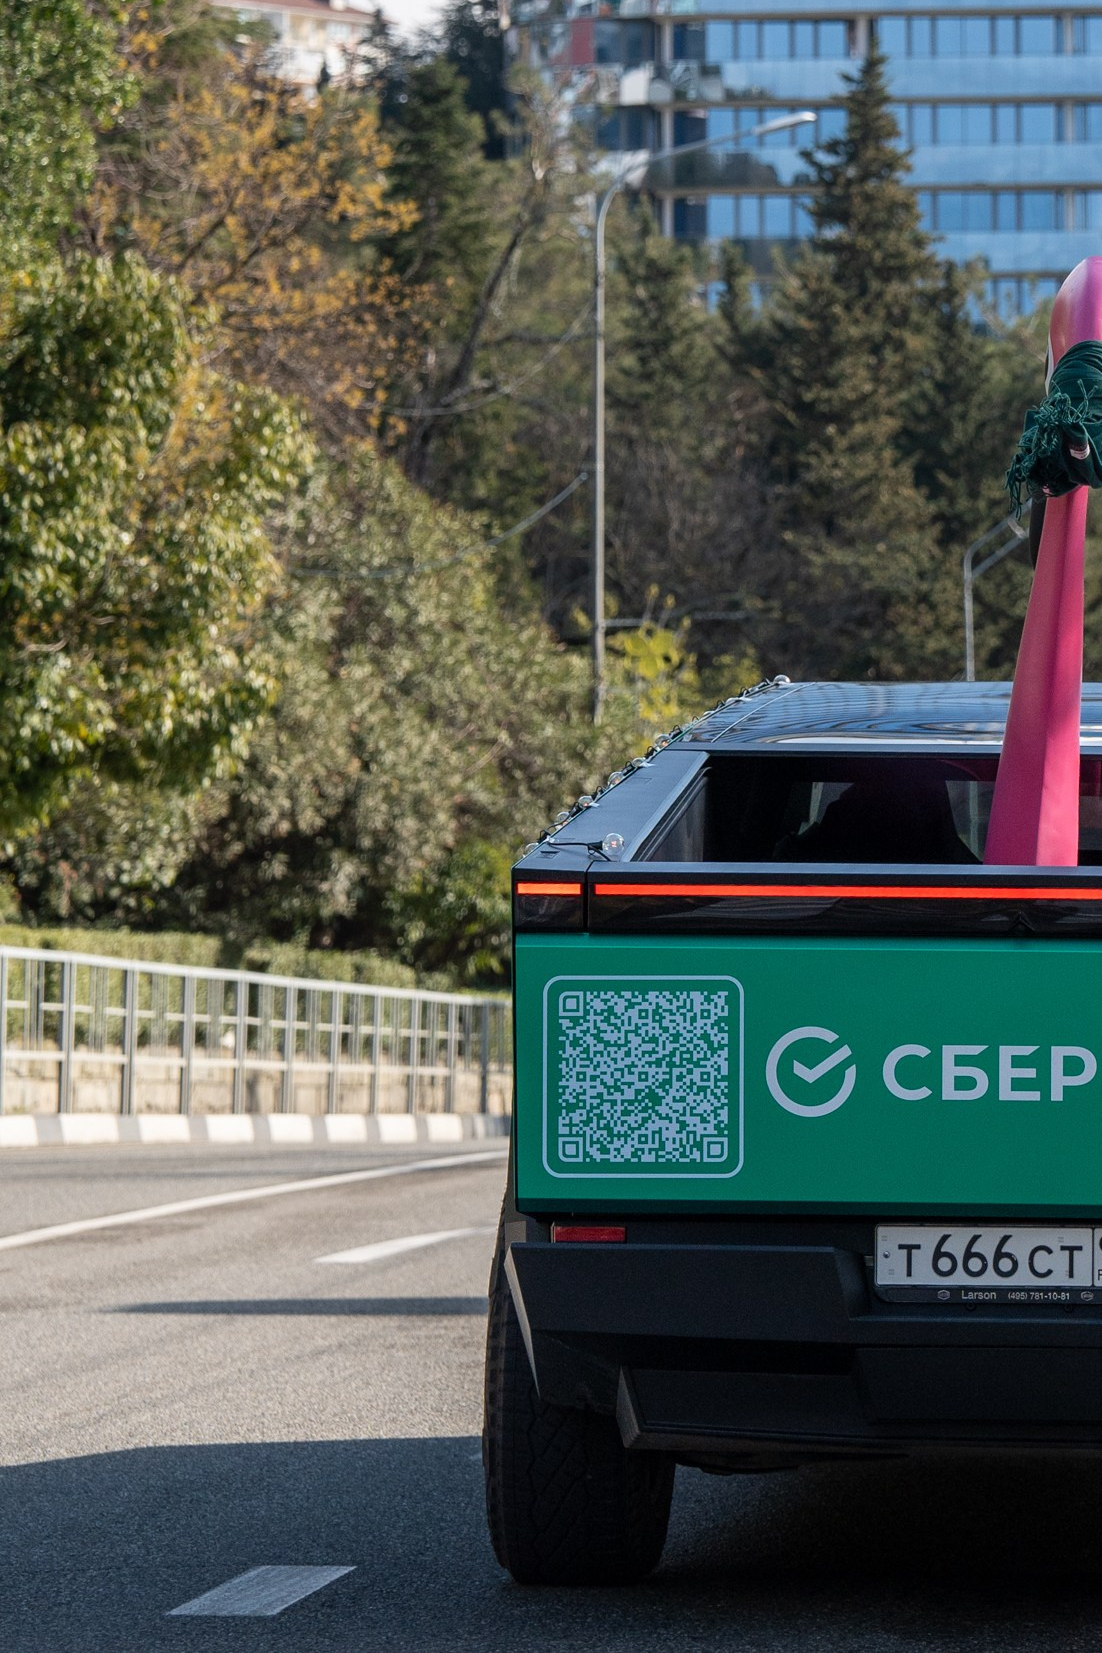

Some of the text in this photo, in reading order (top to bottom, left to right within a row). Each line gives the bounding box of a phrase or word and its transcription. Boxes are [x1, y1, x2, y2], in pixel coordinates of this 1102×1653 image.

[882, 1044, 1097, 1101] СБЕР
[961, 1290, 996, 1300] Larson
[1007, 1292, 1027, 1301] (495)
[1030, 1292, 1070, 1301] 781-10-81
